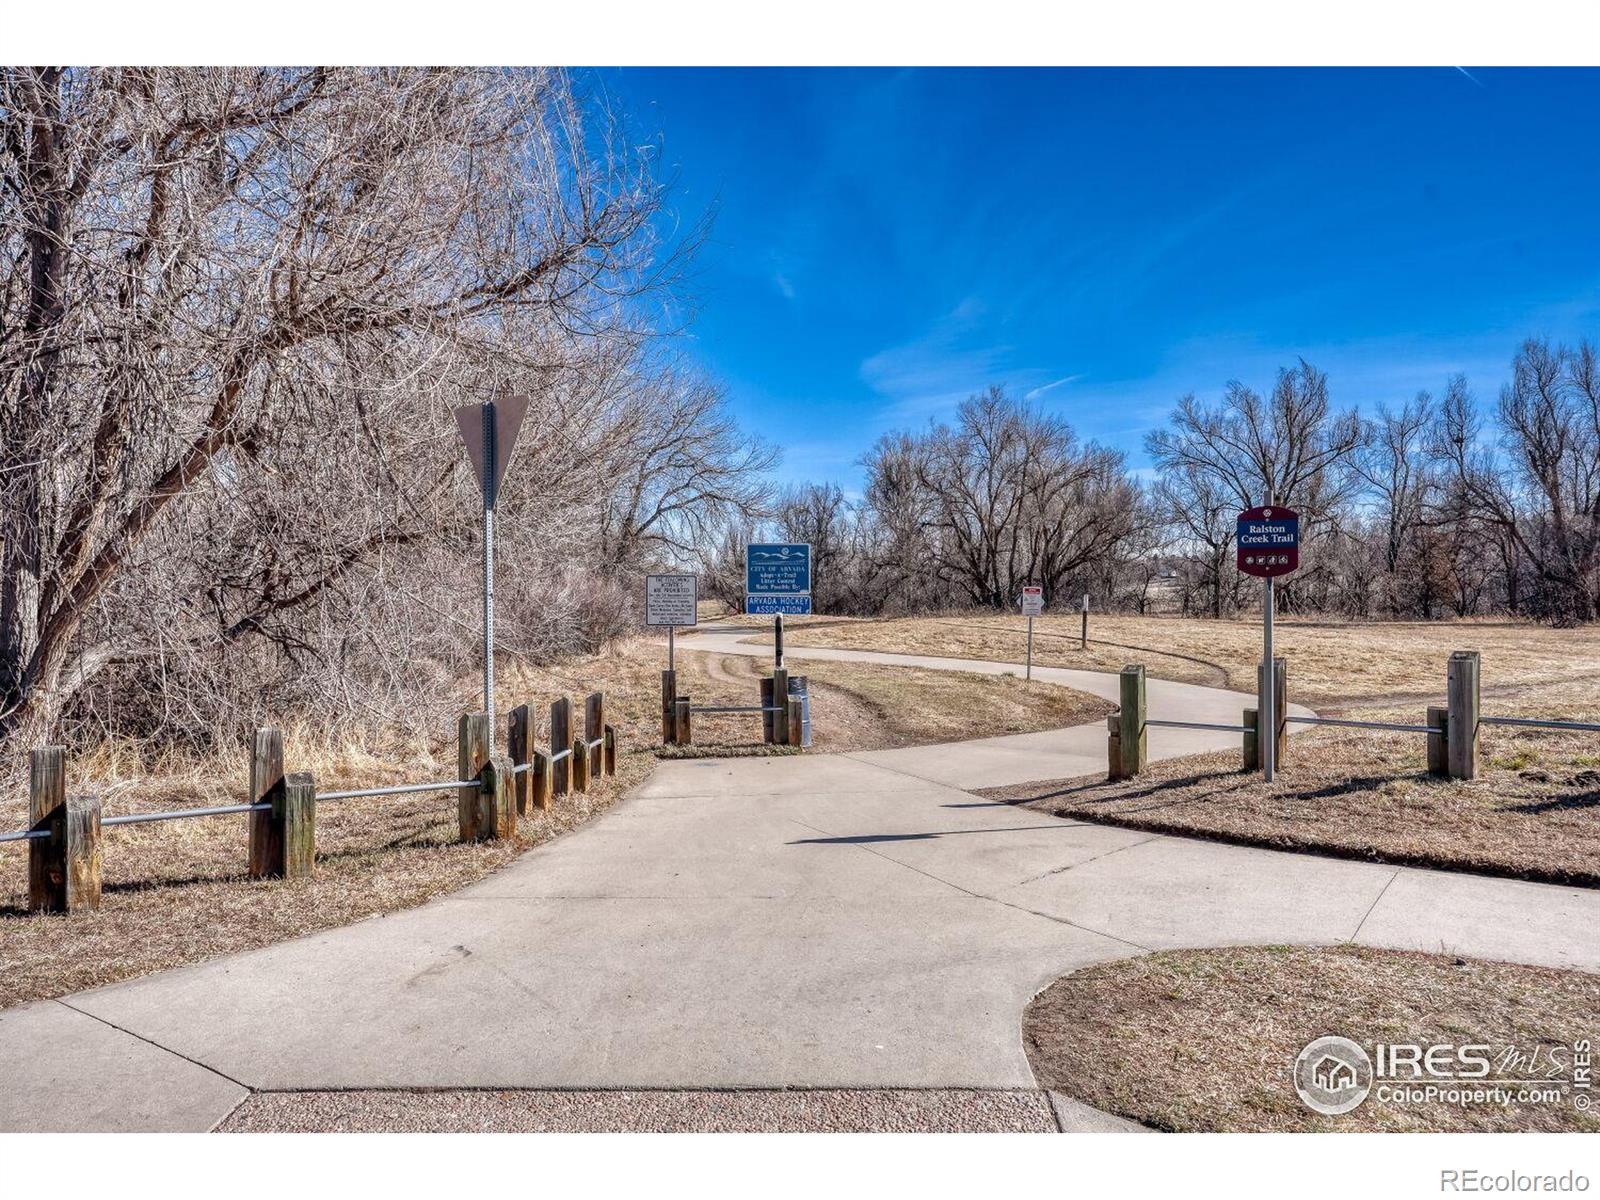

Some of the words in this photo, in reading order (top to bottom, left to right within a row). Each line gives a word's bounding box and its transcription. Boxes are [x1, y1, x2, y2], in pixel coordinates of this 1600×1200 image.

[1250, 525, 1285, 533] Ralston
[1241, 534, 1269, 543] Creek
[1271, 533, 1294, 542] Trail
